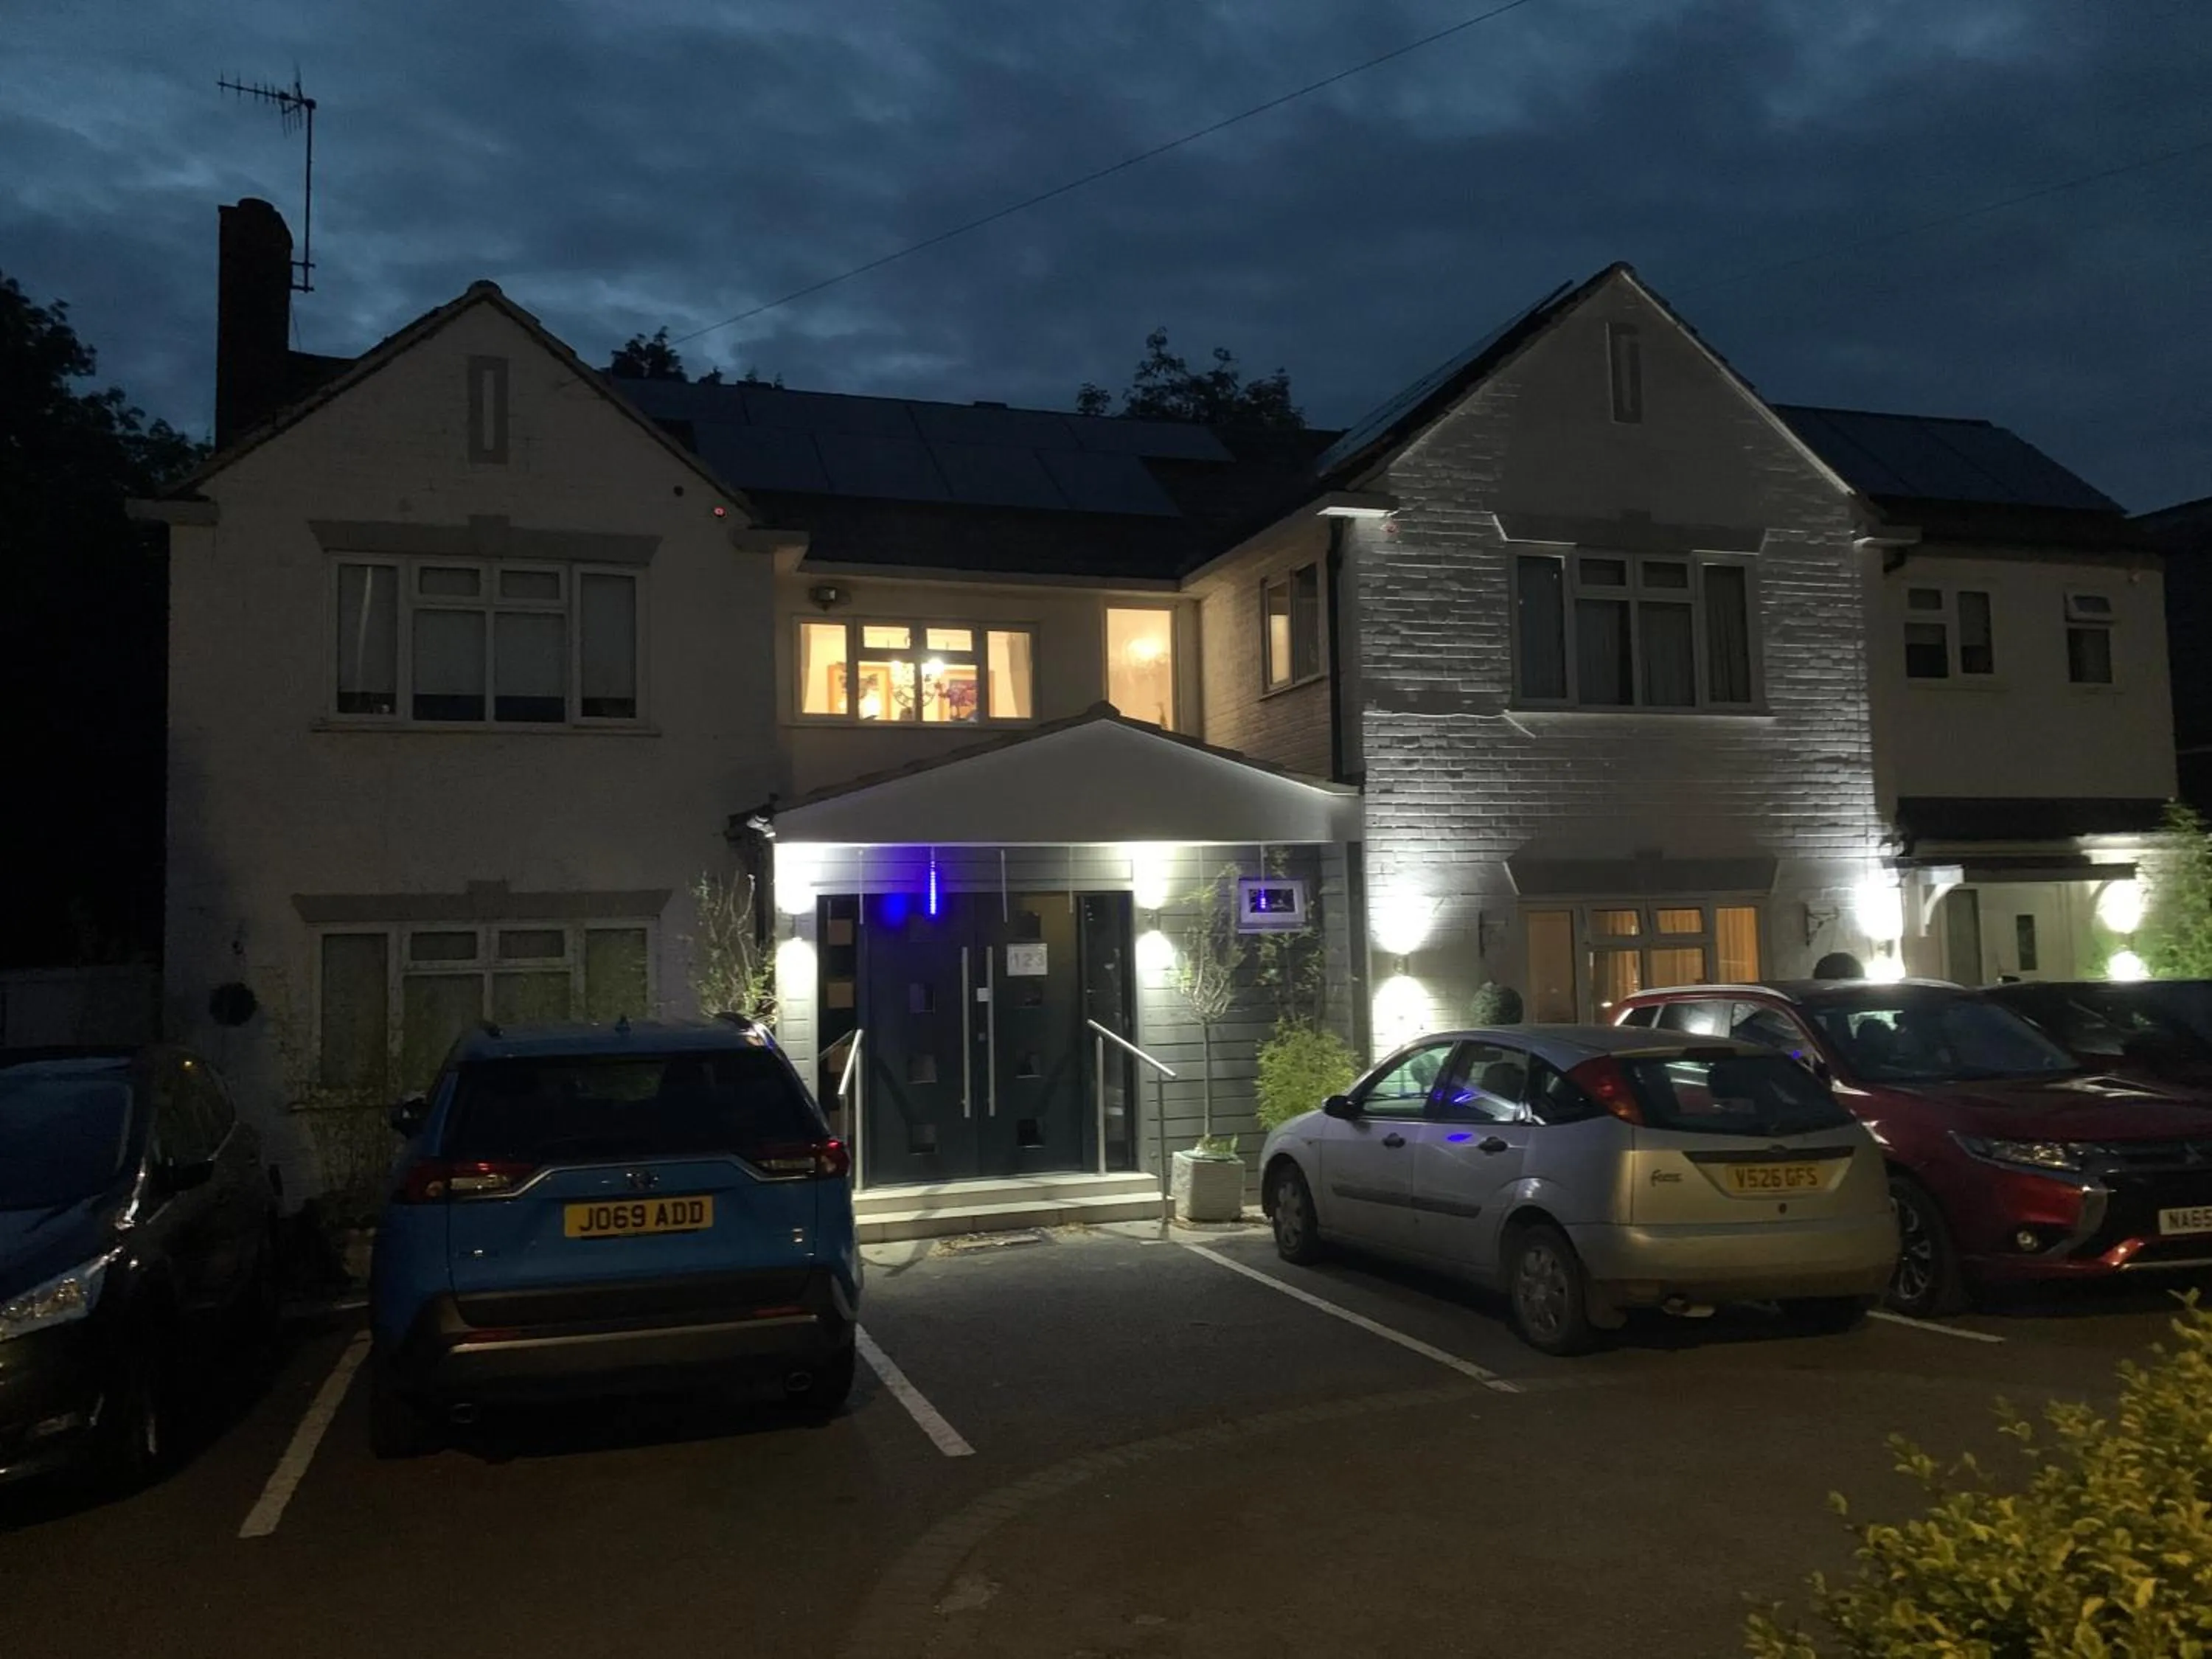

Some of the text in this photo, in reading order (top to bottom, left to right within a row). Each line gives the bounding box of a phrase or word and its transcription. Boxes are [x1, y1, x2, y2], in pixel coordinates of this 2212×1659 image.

[1785, 1166, 1818, 1187] GFS
[579, 1200, 705, 1231] JO69 ADD
